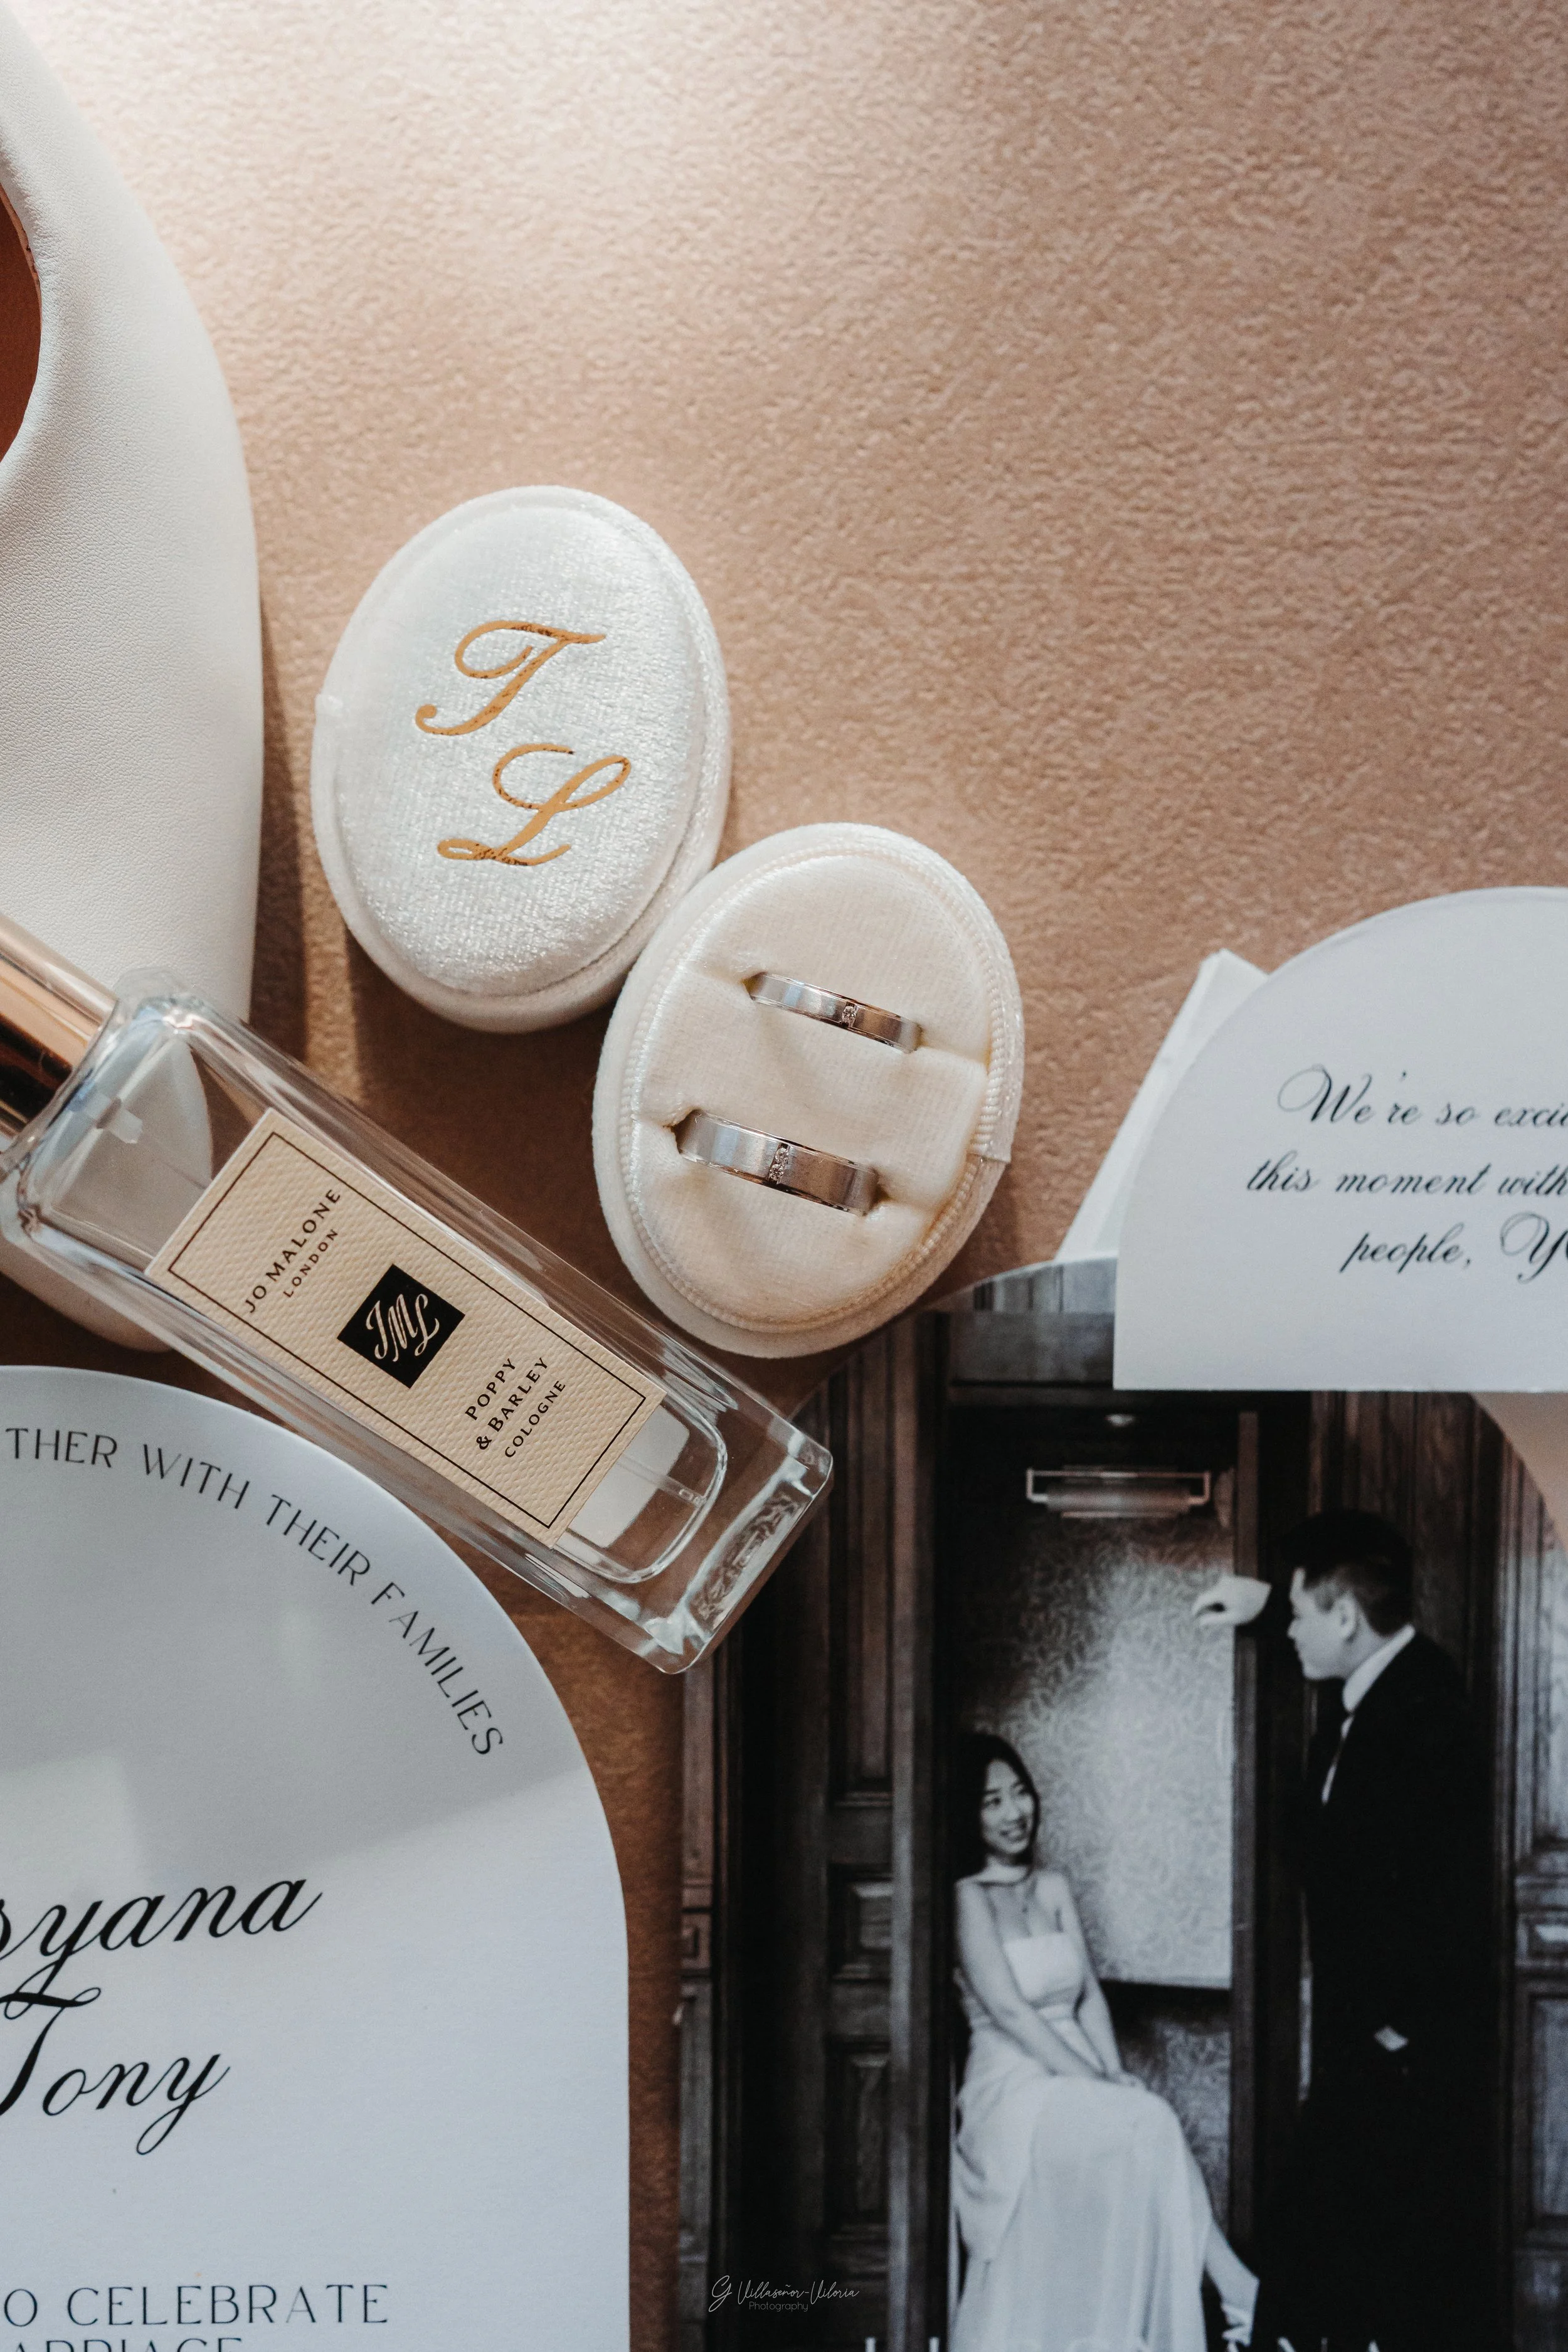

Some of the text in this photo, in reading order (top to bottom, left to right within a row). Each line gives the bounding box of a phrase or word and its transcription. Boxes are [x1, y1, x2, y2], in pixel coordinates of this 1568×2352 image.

[438, 743, 632, 866] L
[1277, 1063, 1421, 1125] We're
[1435, 1102, 1480, 1127] so
[1247, 1150, 1568, 1196] this moment with
[245, 1189, 341, 1313] JO MALONE
[283, 1228, 339, 1298] LONDON
[1339, 1212, 1568, 1284] people, Y
[465, 1357, 517, 1421] POPPY
[475, 1356, 549, 1451] & BARLEY
[505, 1380, 566, 1458] COLOGNE
[5, 1428, 504, 1756] THER WITH THEIR FAMILIES
[66, 2284, 388, 2326] CELEBRATE
